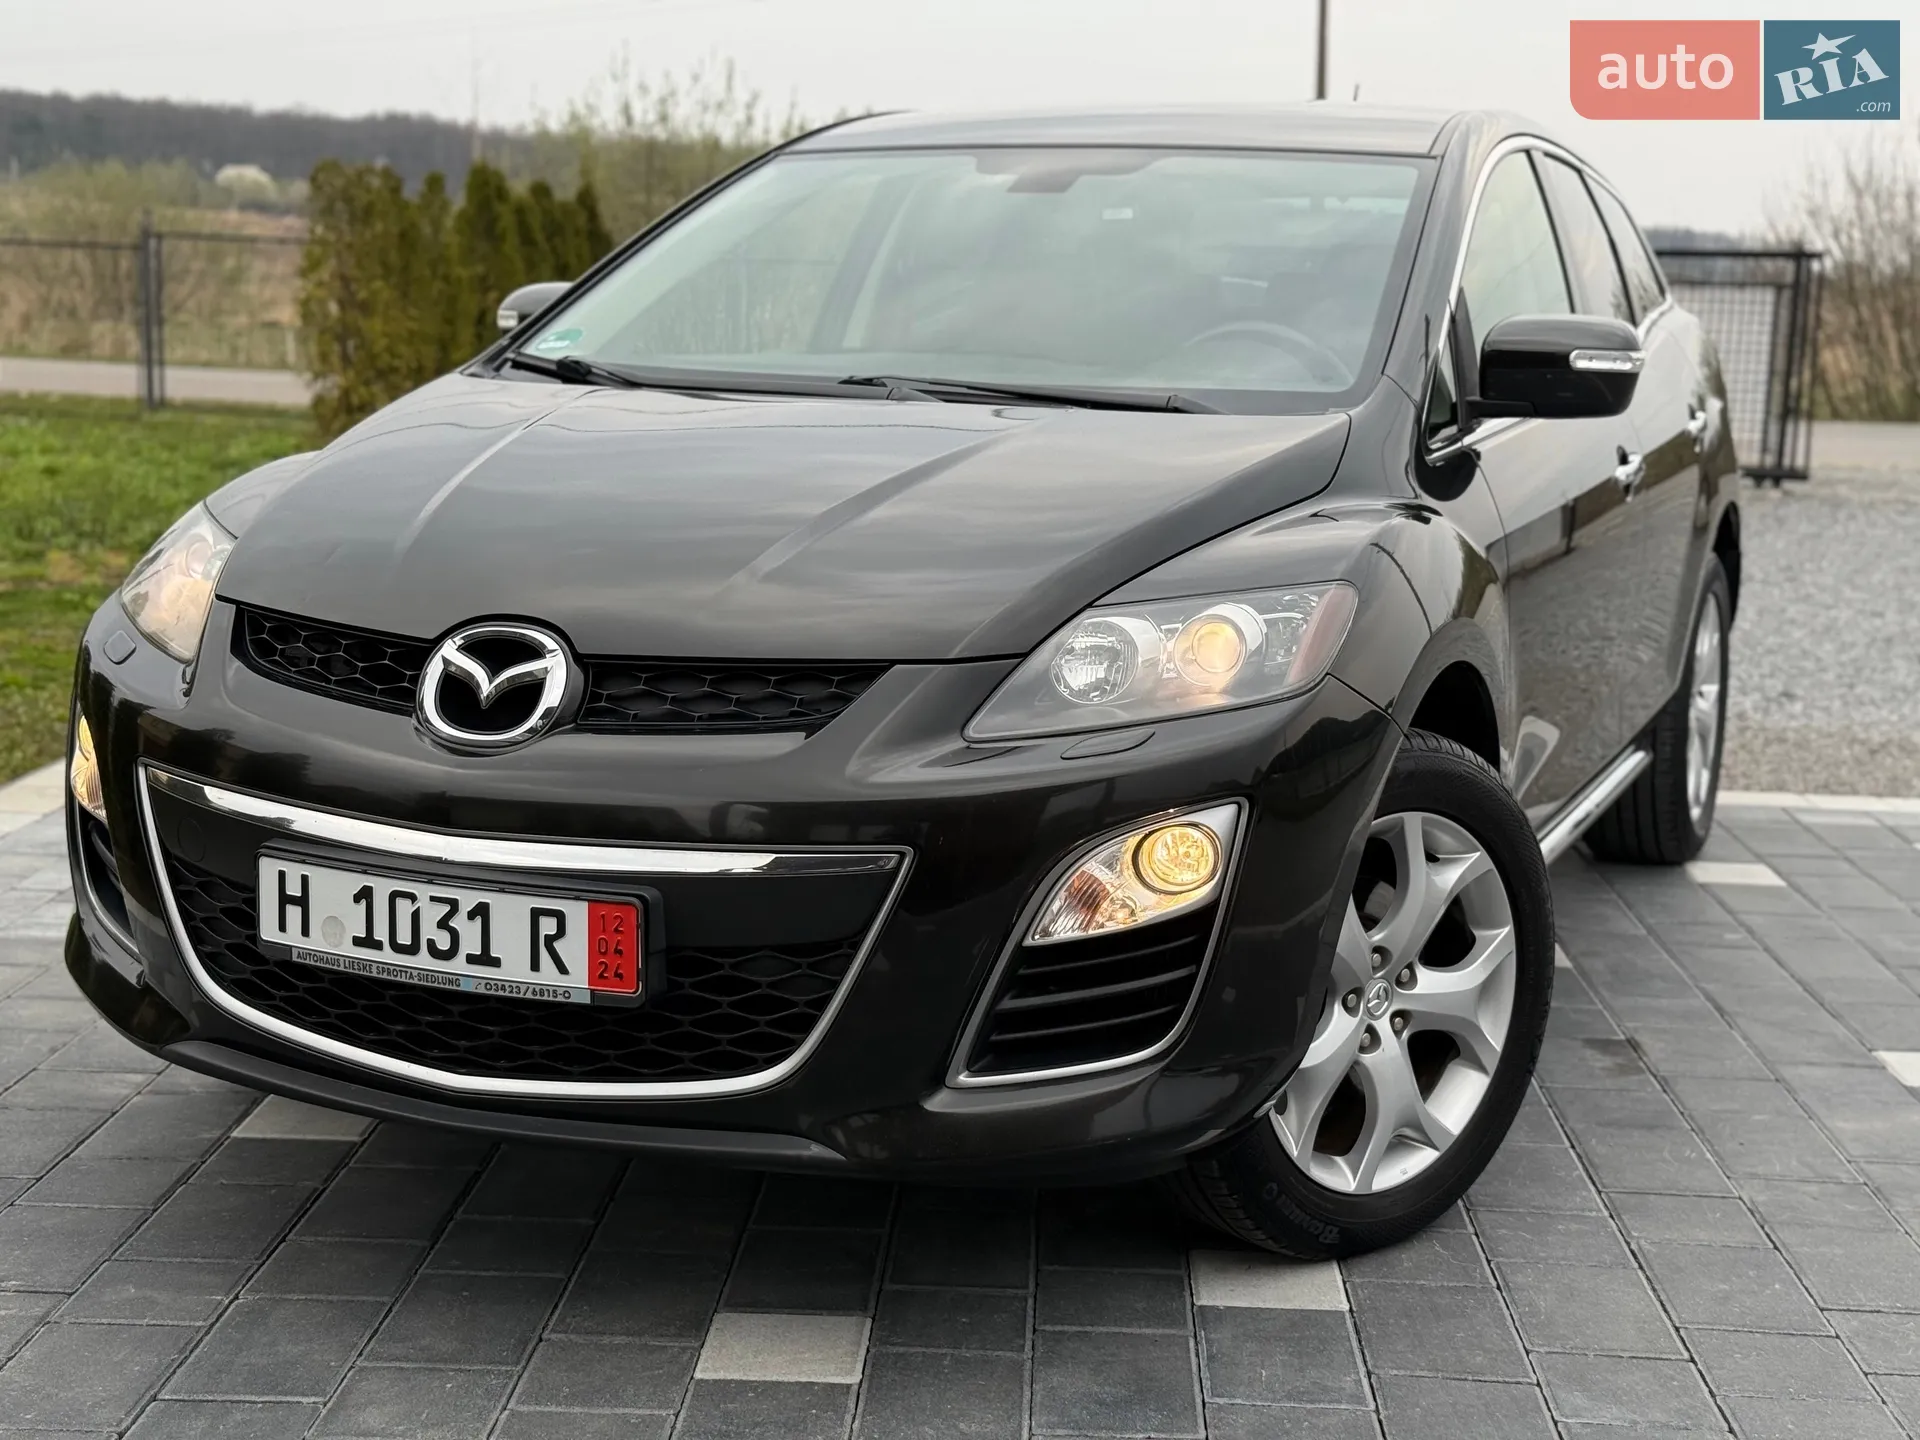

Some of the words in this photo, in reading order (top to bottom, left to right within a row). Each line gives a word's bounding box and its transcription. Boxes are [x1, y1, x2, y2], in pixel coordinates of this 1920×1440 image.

[277, 868, 311, 939] H
[351, 883, 502, 969] 1031
[529, 905, 570, 976] R
[599, 911, 625, 934] 12
[597, 935, 624, 957] 04
[296, 950, 342, 969] AUTOHAUS
[343, 958, 374, 975] LIESKE
[375, 964, 461, 989] SPROTTA-SIEDLUNG
[597, 958, 624, 982] 24
